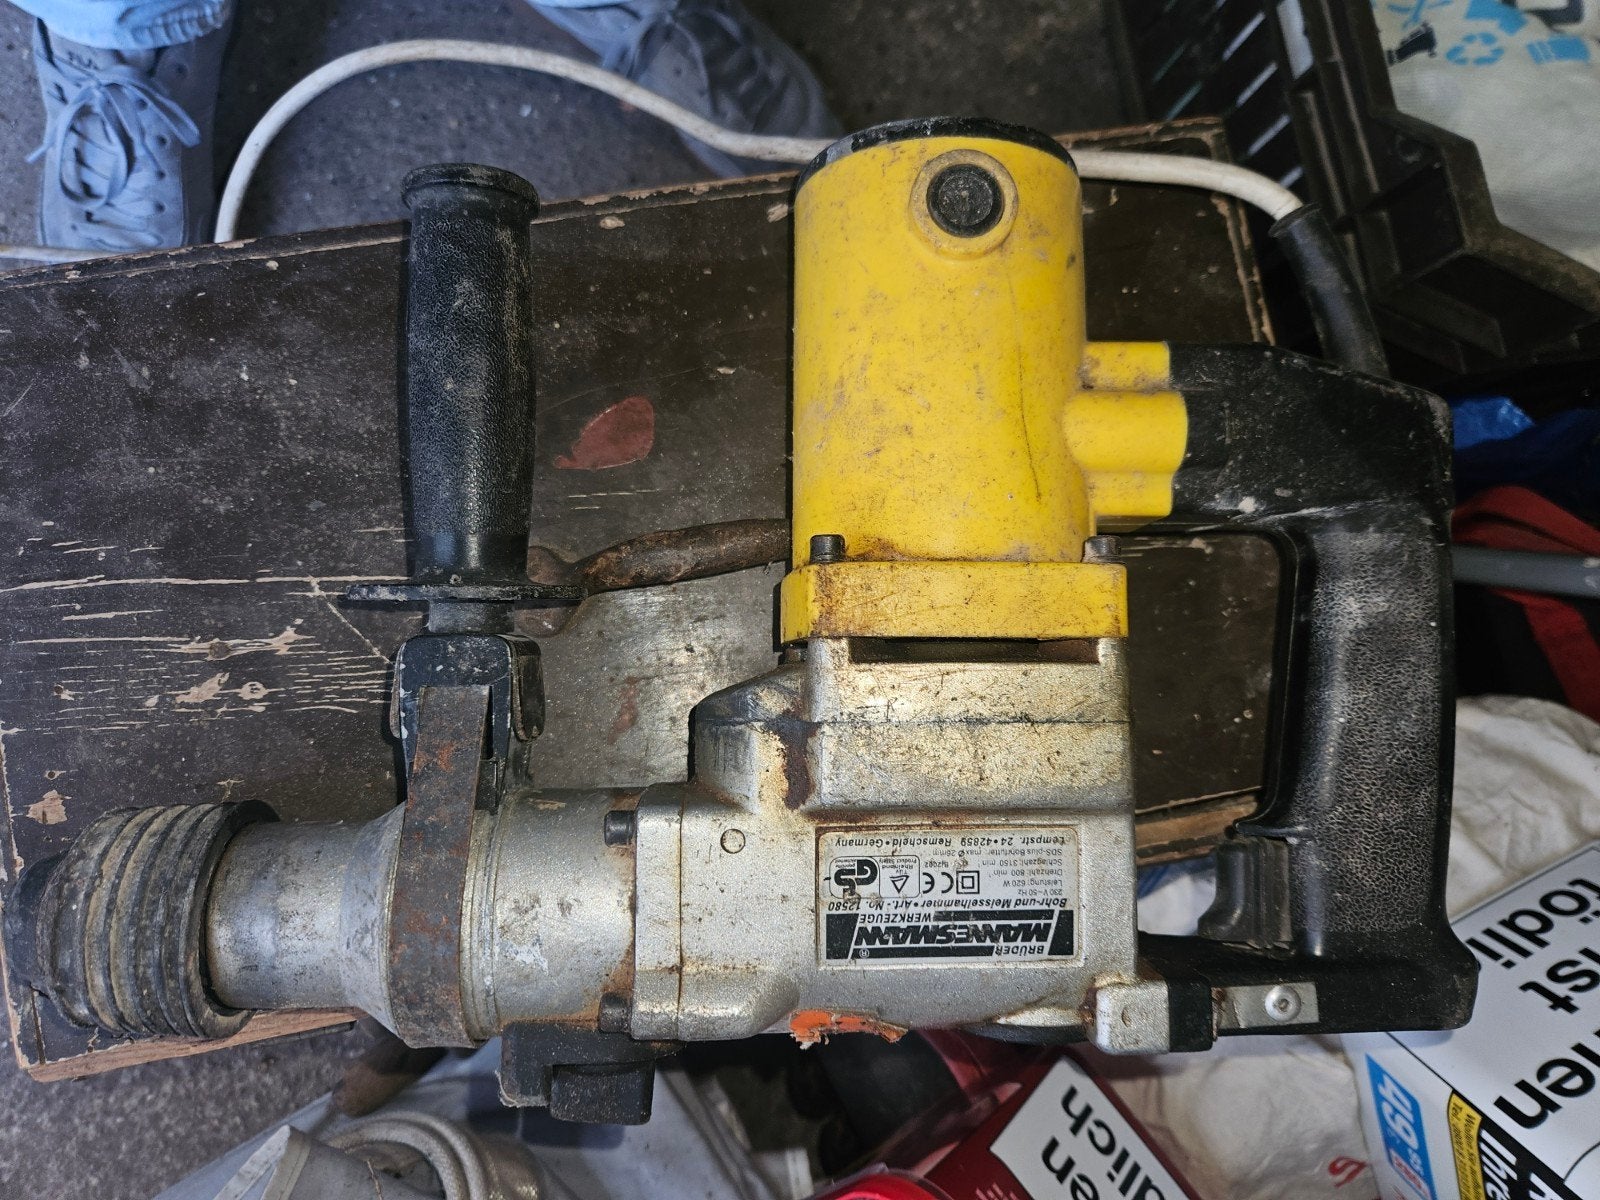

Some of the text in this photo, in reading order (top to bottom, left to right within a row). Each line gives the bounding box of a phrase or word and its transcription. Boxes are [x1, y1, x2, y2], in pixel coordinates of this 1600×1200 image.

[859, 912, 932, 924] WERKZEUGE
[1465, 878, 1600, 970] tödli
[854, 923, 1051, 946] MANNESMANN
[995, 945, 1044, 956] BRÜDER
